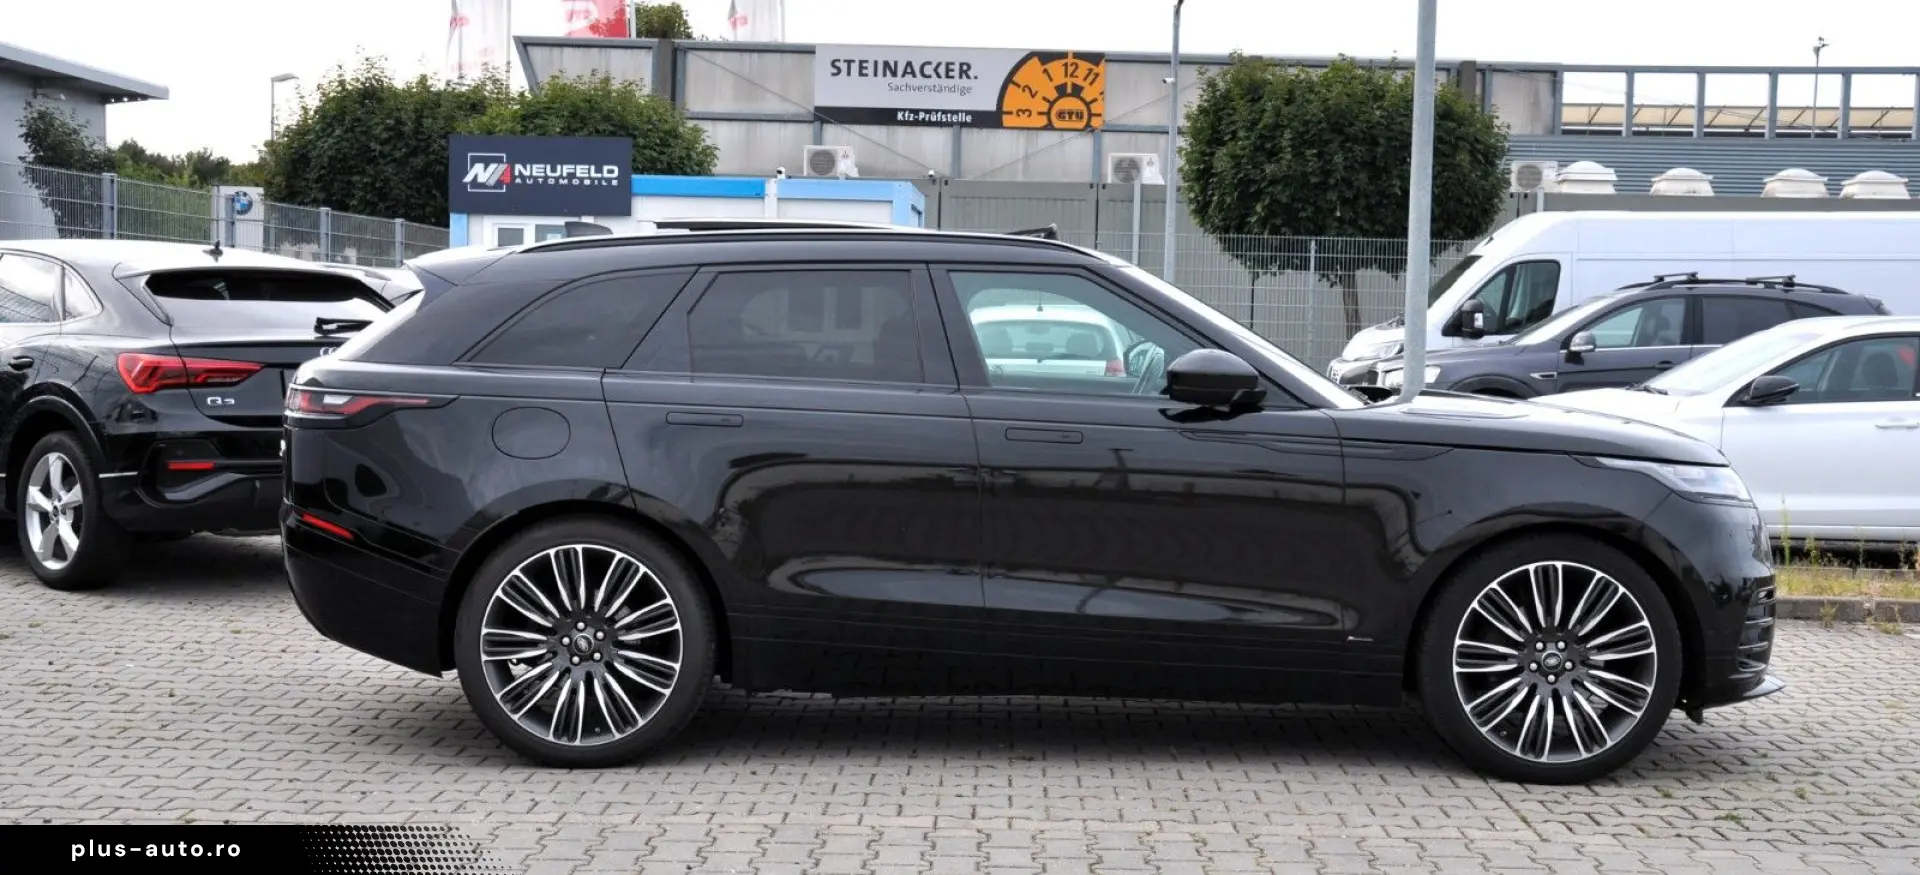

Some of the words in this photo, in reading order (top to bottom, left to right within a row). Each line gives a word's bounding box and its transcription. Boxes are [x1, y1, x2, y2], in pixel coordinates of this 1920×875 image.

[1042, 68, 1053, 82] 1
[1062, 61, 1080, 78] 12
[1083, 68, 1100, 86] 11
[887, 82, 973, 96] Sachverständige
[1022, 84, 1038, 99] 2
[896, 111, 973, 123] Kfz-Prüfstelle
[1016, 108, 1033, 118] 3
[514, 164, 619, 178] NEUFELD
[514, 178, 619, 186] AUTOMOBILE
